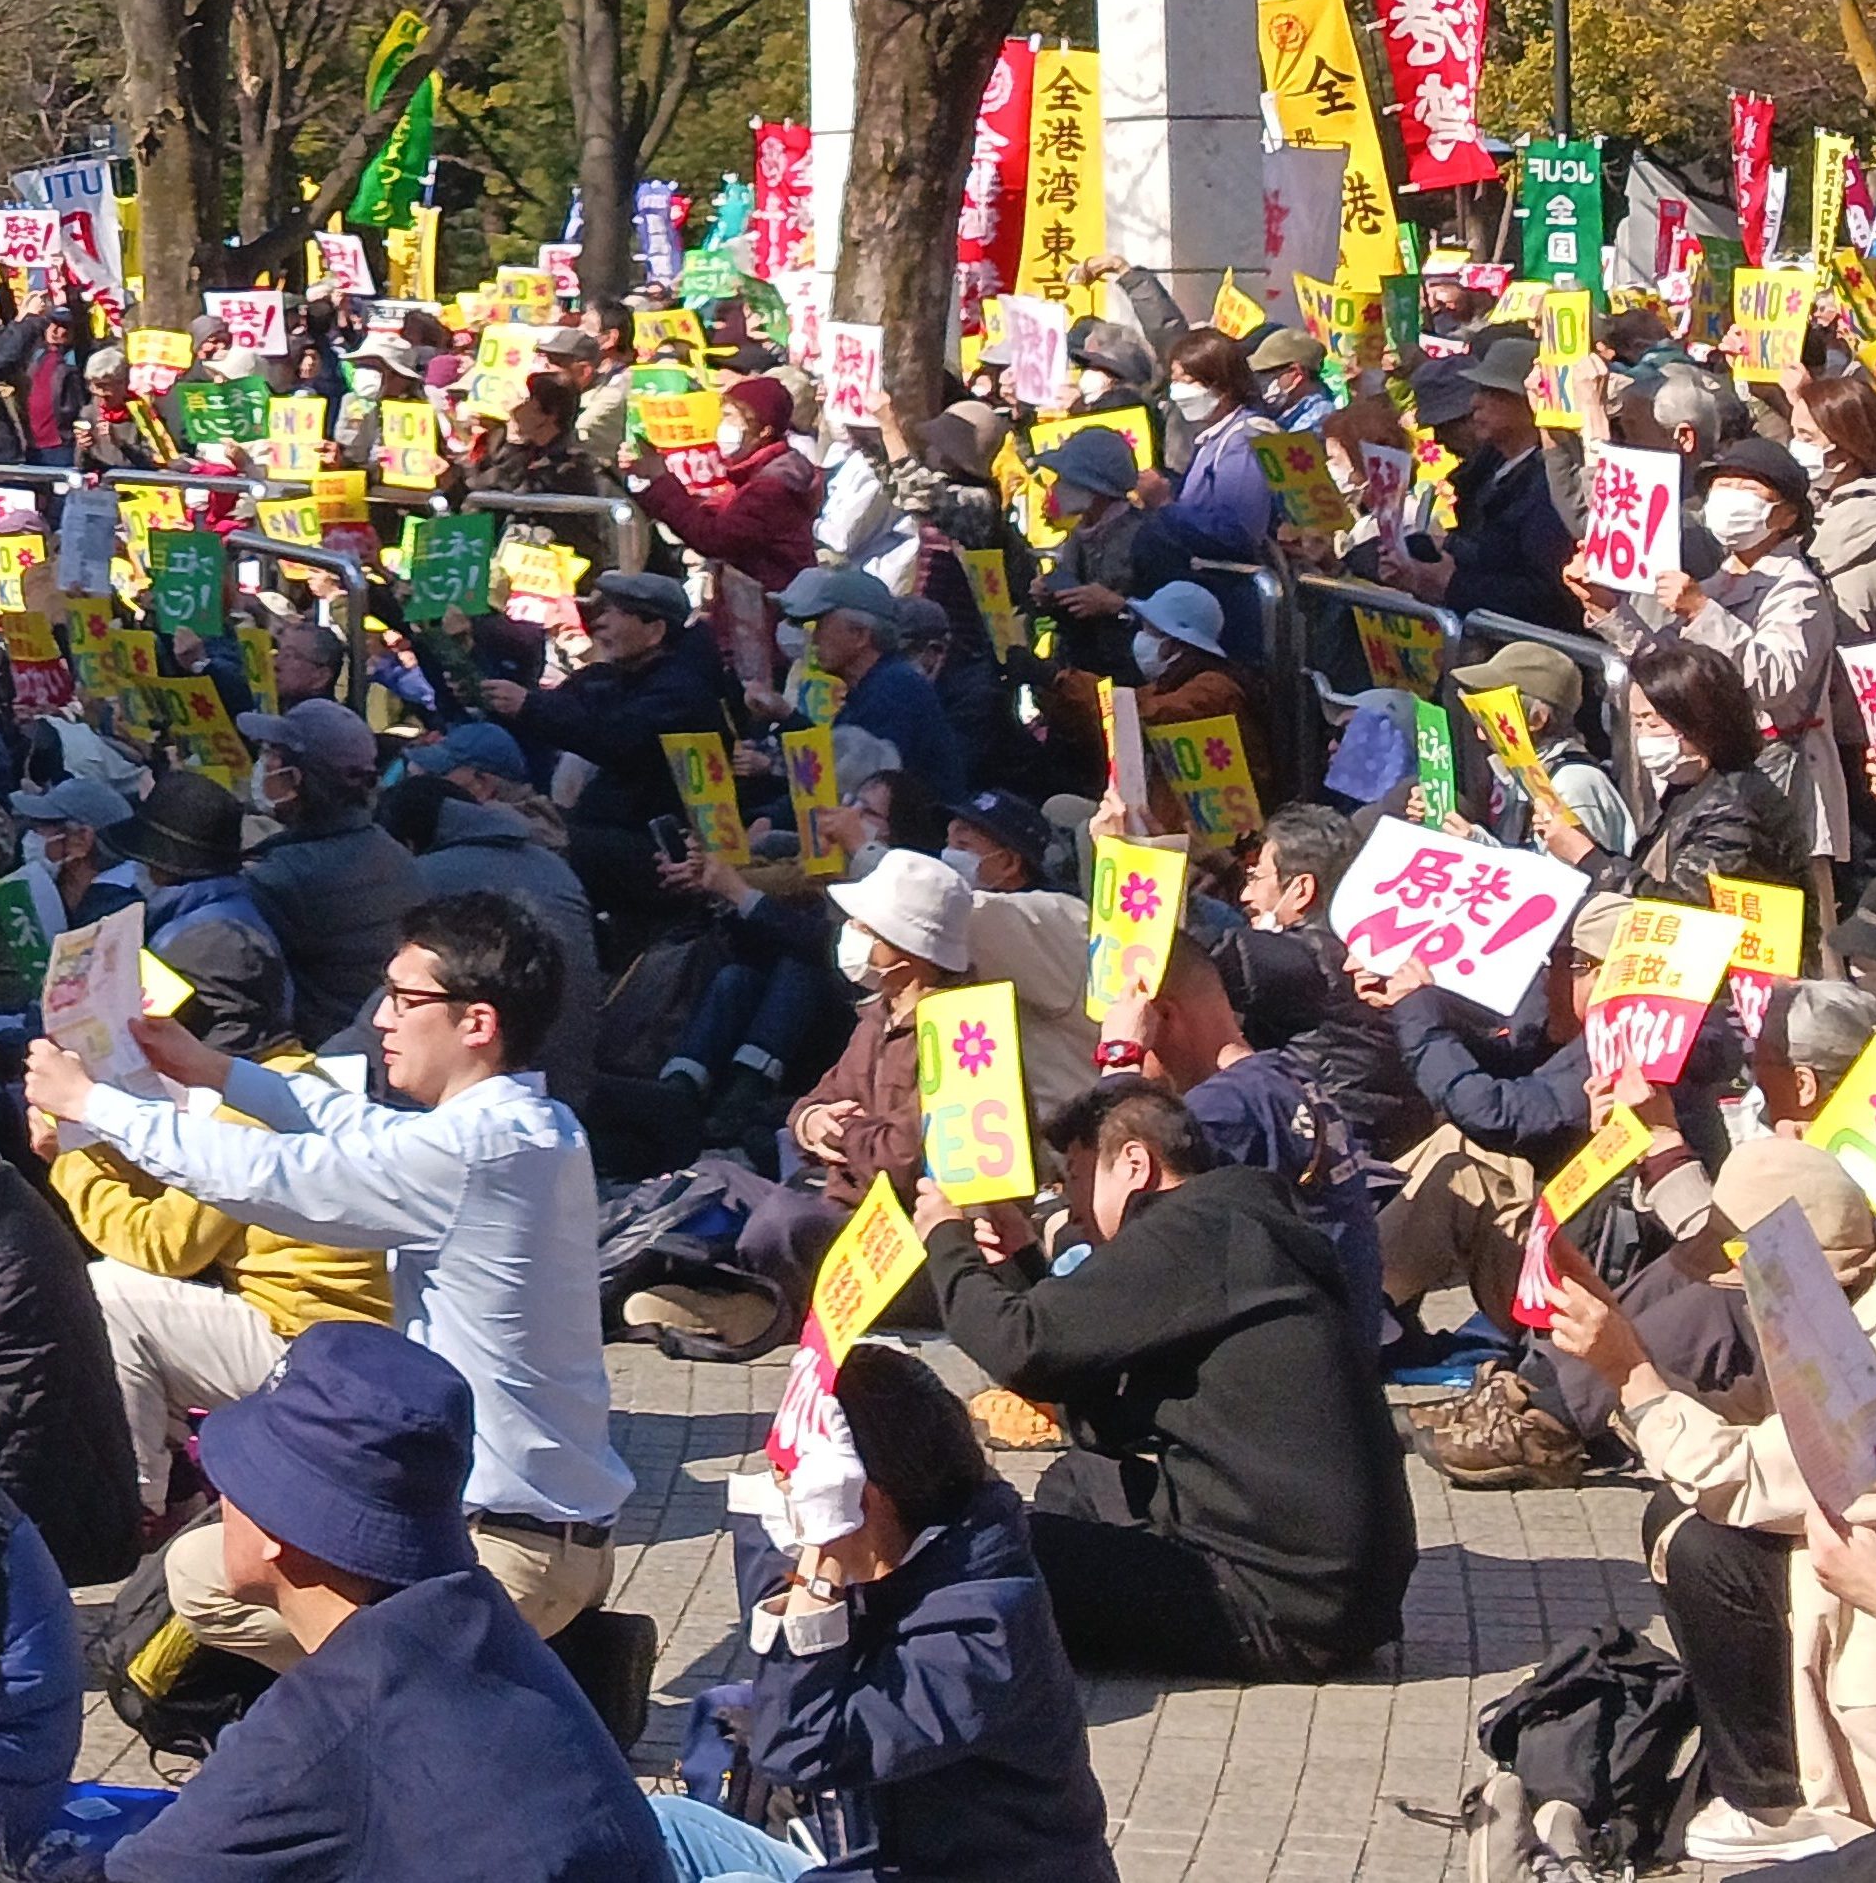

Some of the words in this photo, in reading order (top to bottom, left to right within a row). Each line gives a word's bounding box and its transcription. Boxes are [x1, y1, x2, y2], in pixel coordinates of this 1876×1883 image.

[1754, 281, 1782, 322] NO
[1374, 847, 1513, 928] 原発
[1347, 895, 1558, 976] NO!
